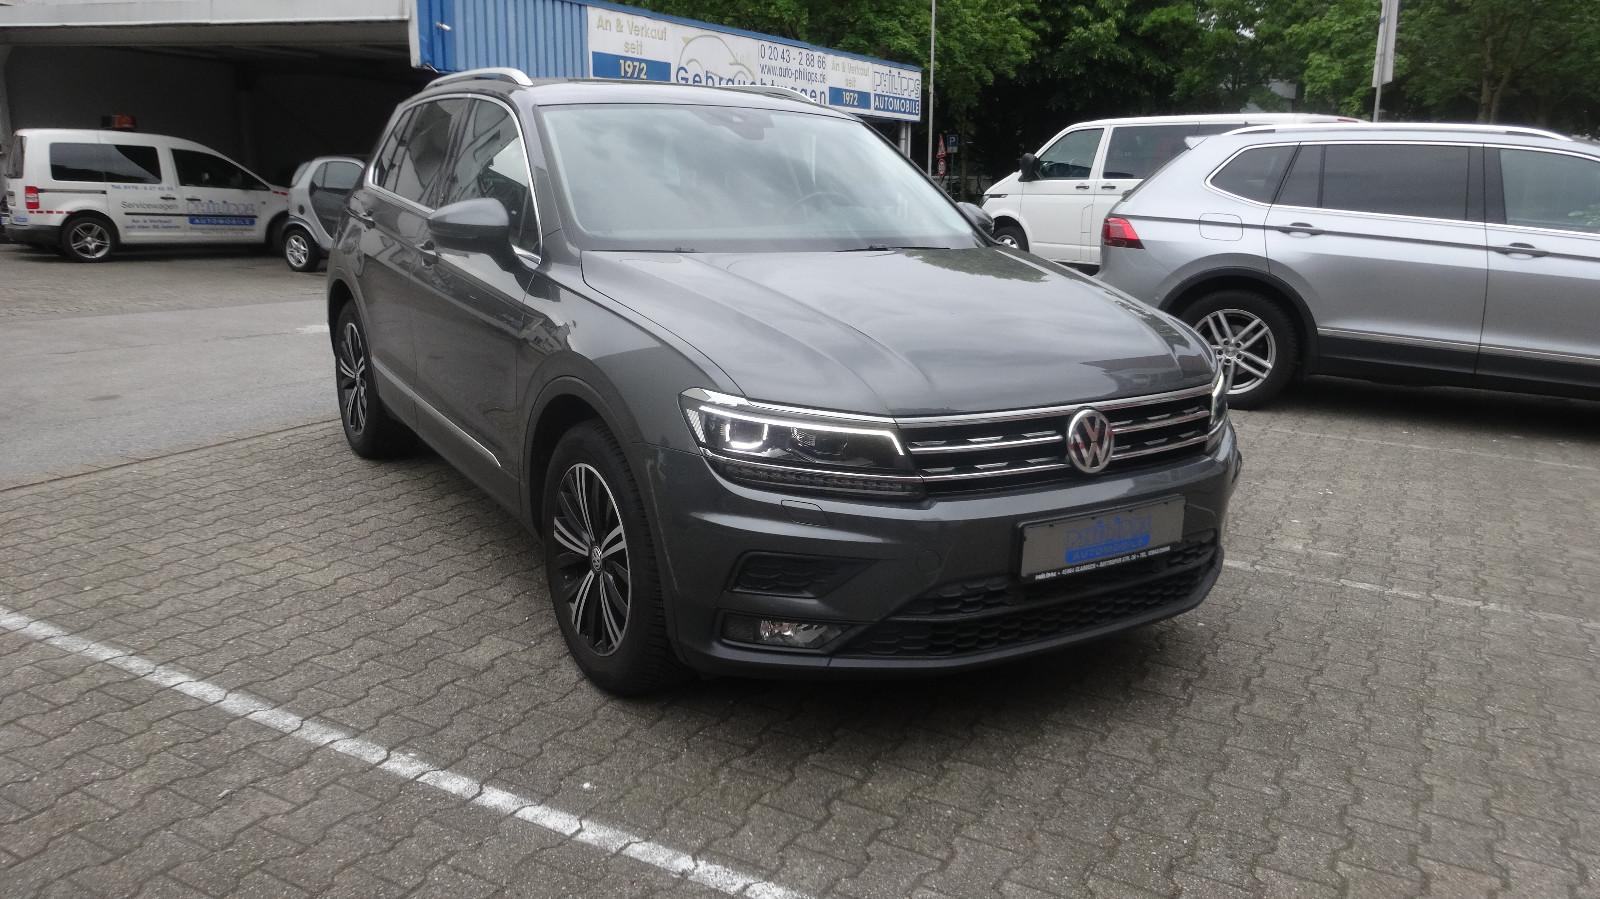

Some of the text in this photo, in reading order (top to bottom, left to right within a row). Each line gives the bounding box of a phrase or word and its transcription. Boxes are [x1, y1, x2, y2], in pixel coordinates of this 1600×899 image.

[597, 15, 667, 41] An & Verkauf
[624, 40, 643, 55] seit
[760, 44, 766, 59] 0
[768, 45, 778, 61] 20
[780, 48, 791, 63] 43
[798, 51, 803, 65] 2
[619, 59, 647, 79] 1972
[842, 91, 859, 105] 1972
[875, 94, 919, 114] AUTOMOBILE
[949, 136, 956, 145] P
